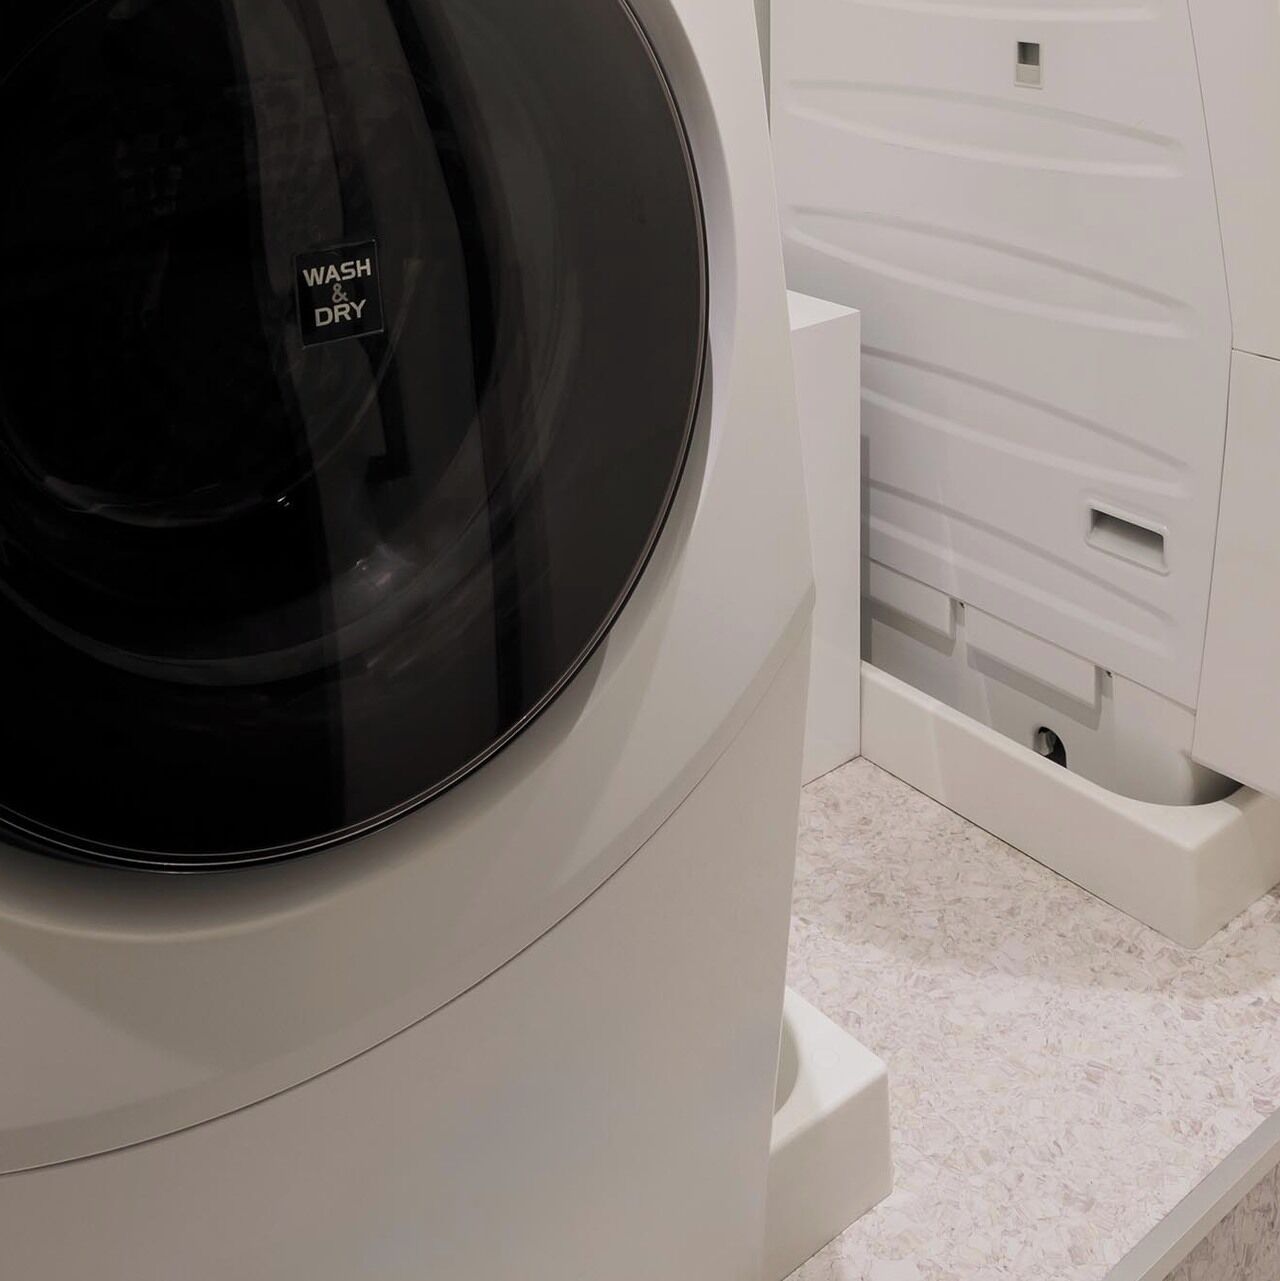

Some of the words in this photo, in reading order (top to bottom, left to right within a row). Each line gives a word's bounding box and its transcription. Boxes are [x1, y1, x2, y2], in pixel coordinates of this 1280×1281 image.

[303, 258, 372, 287] WASH
[331, 283, 349, 303] &
[314, 299, 367, 327] DRY
